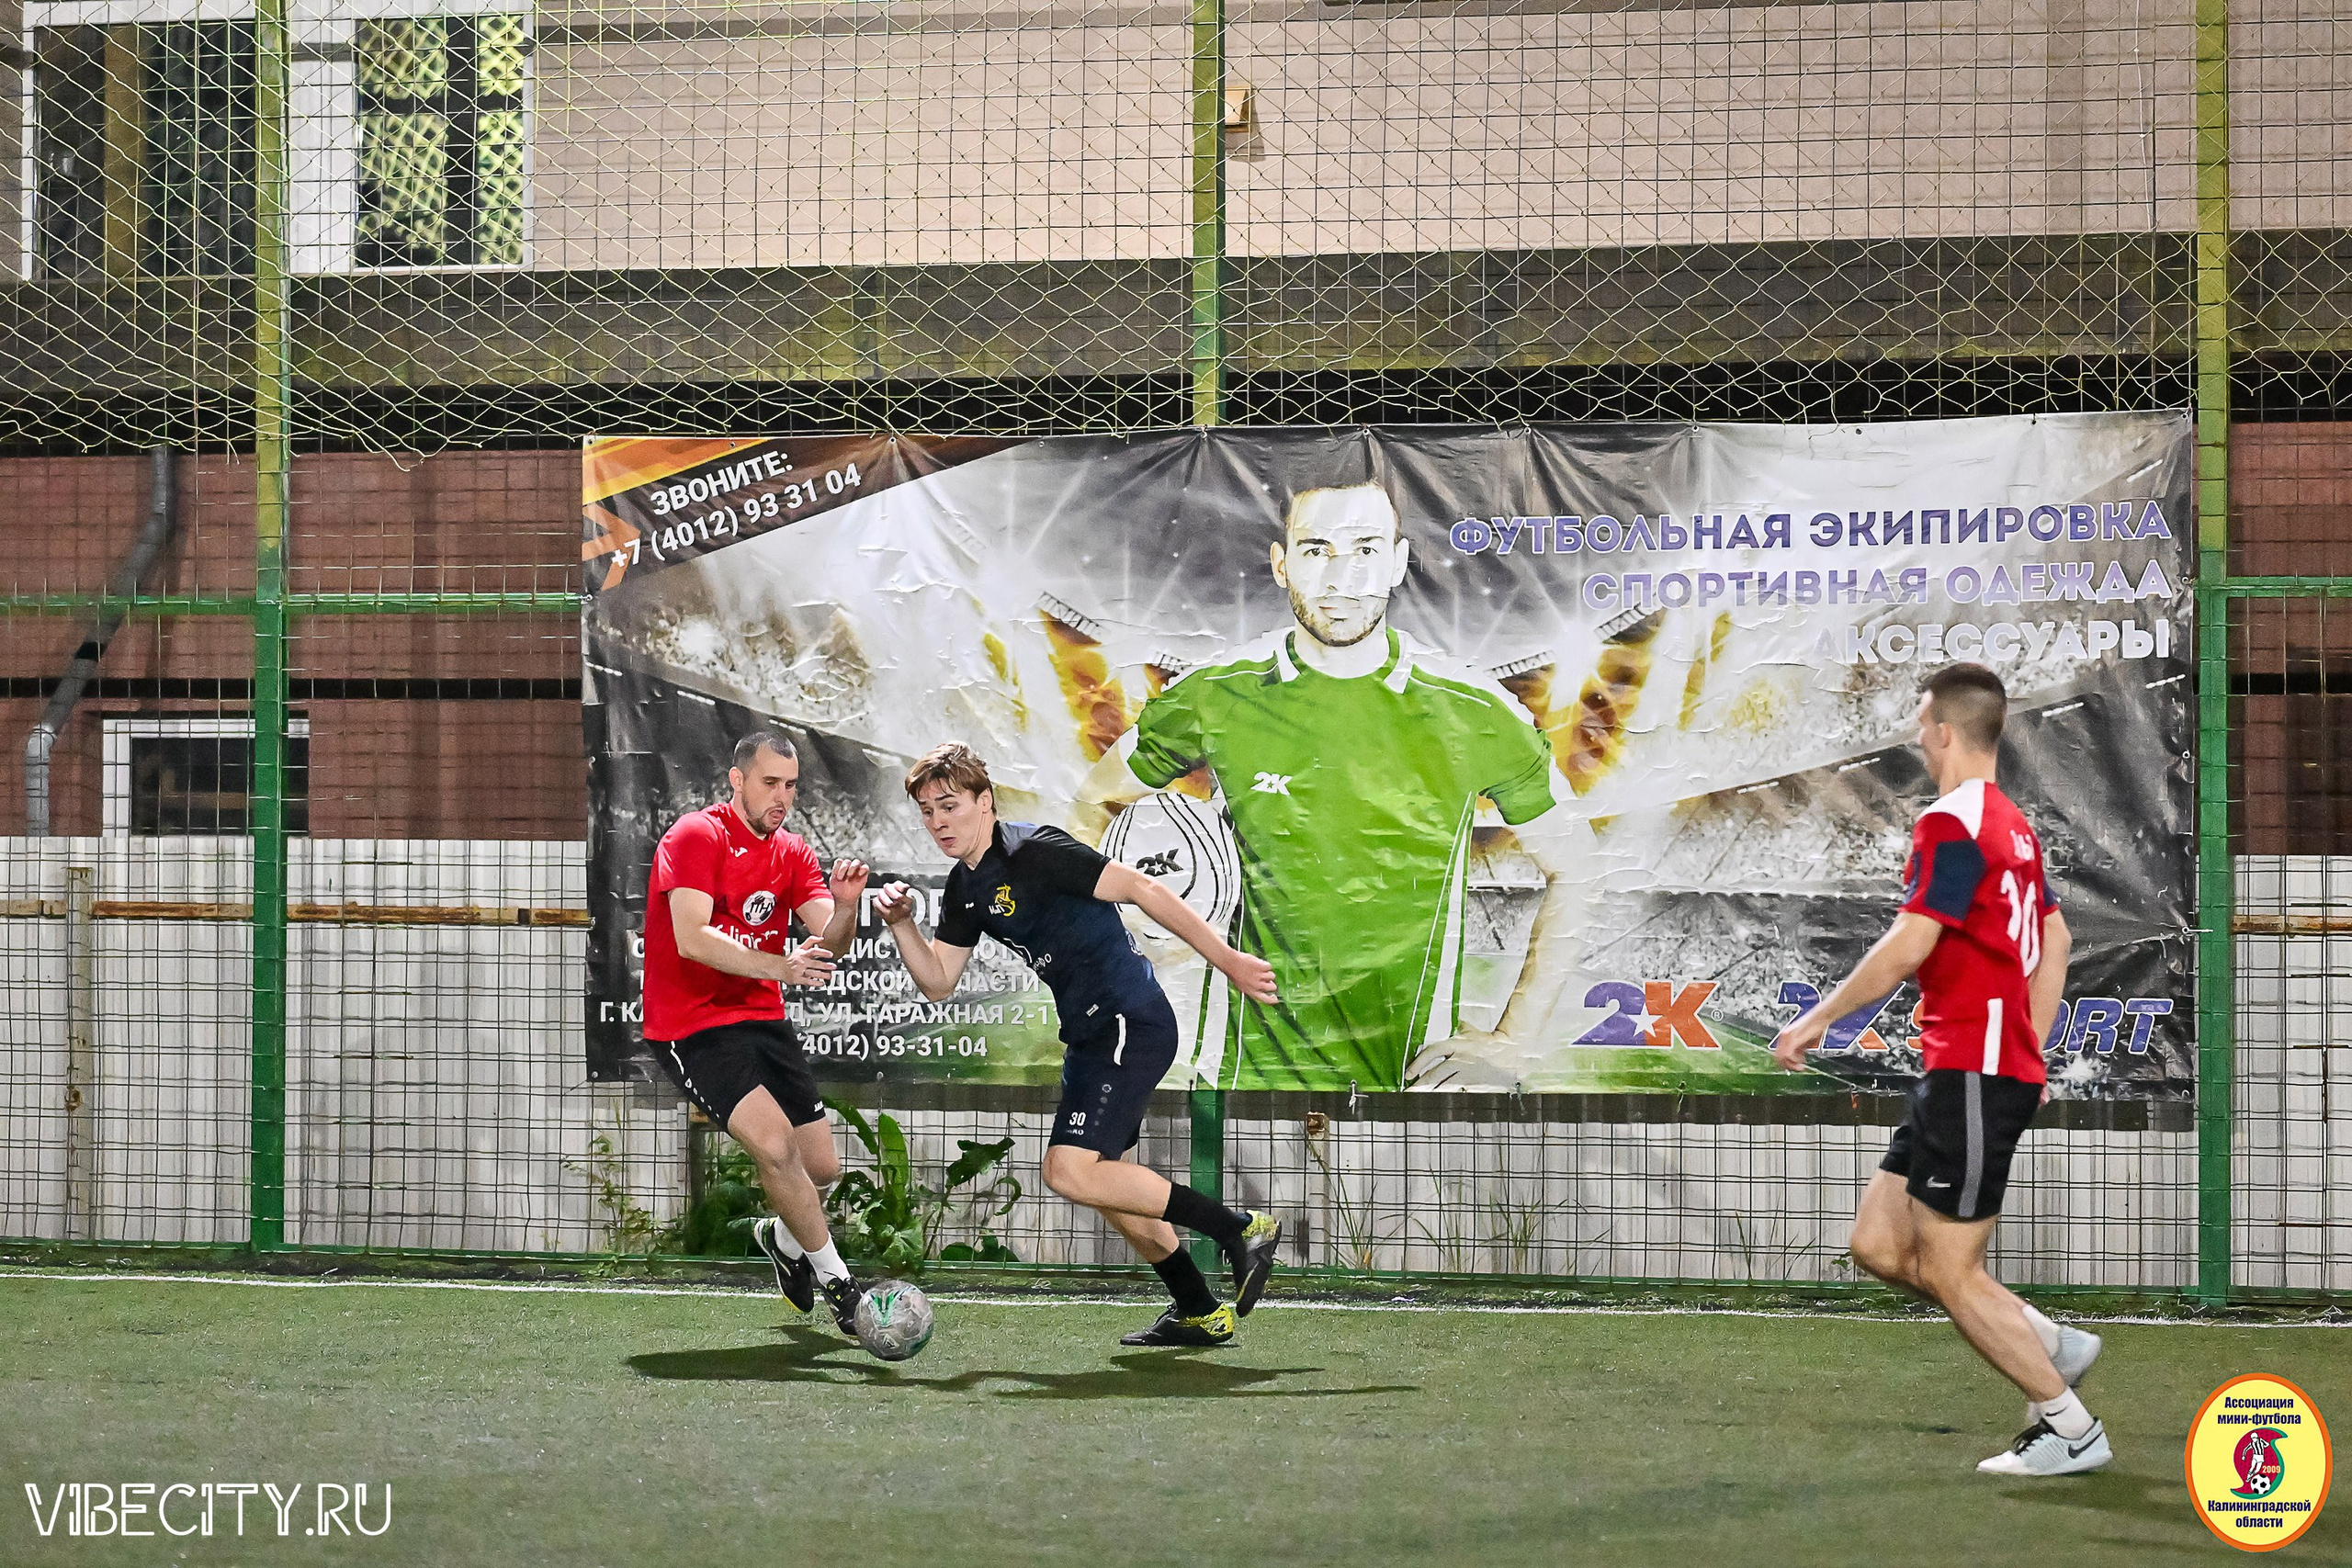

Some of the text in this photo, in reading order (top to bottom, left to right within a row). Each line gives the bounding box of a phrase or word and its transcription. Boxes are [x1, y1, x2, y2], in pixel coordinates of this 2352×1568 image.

[650, 450, 794, 515] ЗВОНИТЕ:
[611, 462, 862, 568] +7 (4012) 93 31 04
[1449, 500, 2171, 555] ФУТБОЛЬНАЯ ЭКИПИРОВКА
[1582, 558, 2171, 610] СПОРТИВНАЯ ОДЕЖДА
[1812, 619, 2170, 664] АКСЕССУАРЫ
[600, 1001, 615, 1022] Г.
[866, 1002, 1003, 1024] ГАРАЖНАЯ
[1570, 980, 1722, 1050] 2K
[876, 1034, 988, 1057] 93-31-04
[1069, 1111, 1087, 1126] 30
